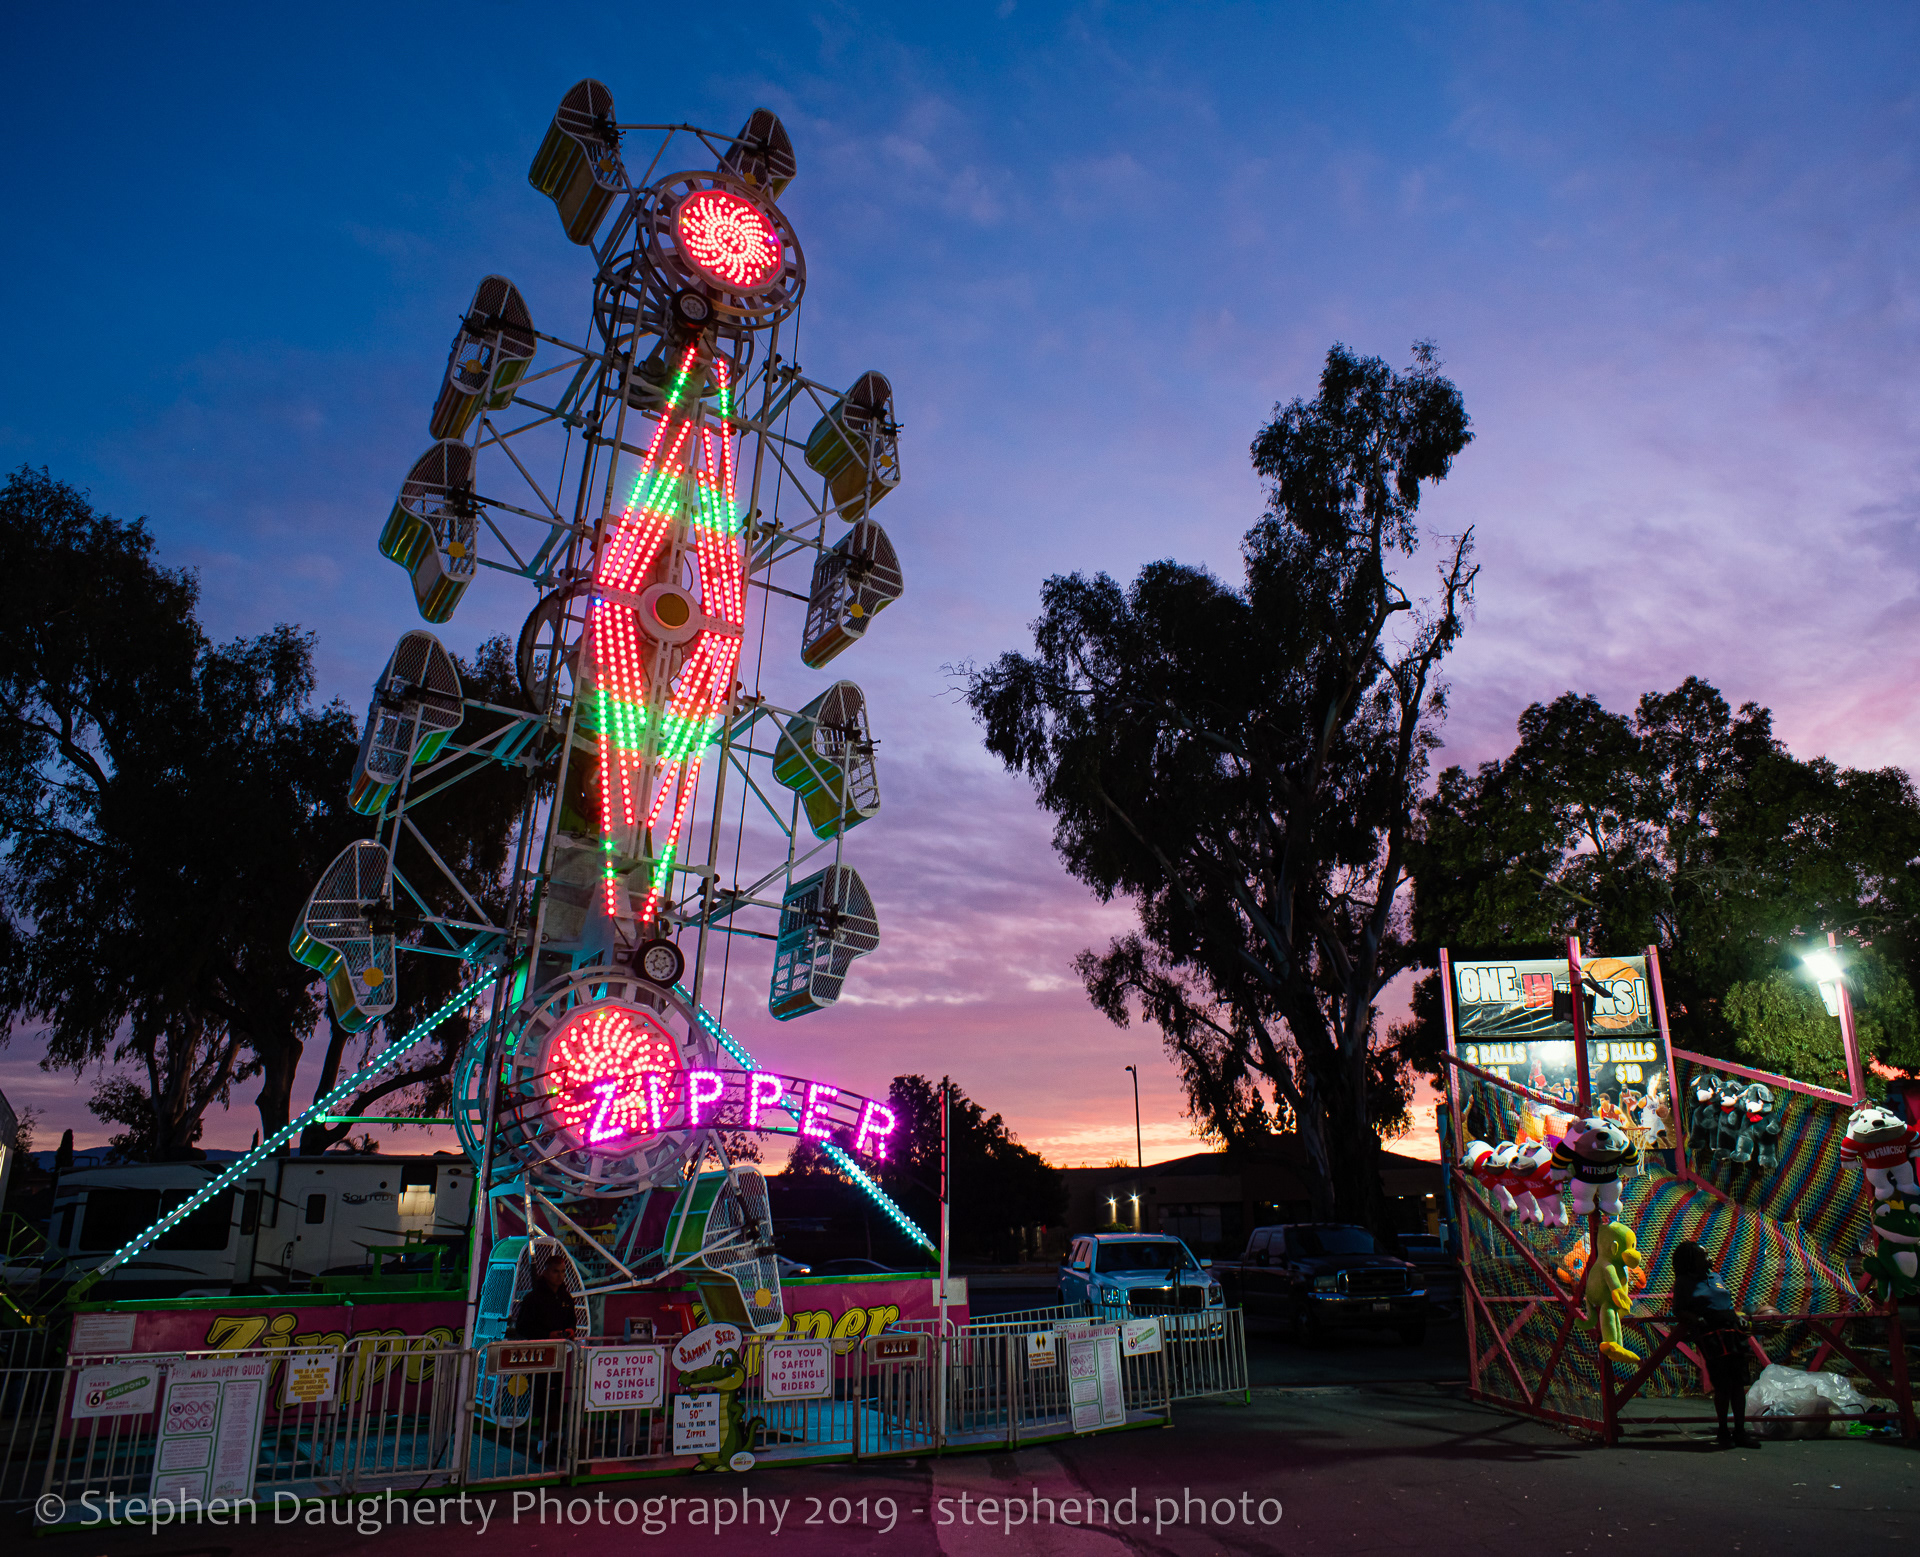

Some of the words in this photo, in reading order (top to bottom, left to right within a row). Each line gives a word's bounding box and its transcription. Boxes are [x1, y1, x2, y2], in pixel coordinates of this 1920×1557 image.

[1459, 966, 1519, 1004] ONE
[1521, 972, 1553, 1010] IN
[1556, 977, 1648, 1017] NS!
[1466, 1045, 1479, 1064] 2
[1479, 1044, 1526, 1065] BALLS
[1596, 1042, 1609, 1063] 5
[1610, 1042, 1657, 1063] BALLS
[1615, 1064, 1643, 1084] $10
[589, 1070, 897, 1160] ZIPPER
[1864, 1149, 1876, 1159] SAN
[1875, 1145, 1906, 1158] FRANCISCO
[342, 1192, 396, 1202] SOLITUDE
[1068, 1331, 1076, 1340] FUN
[1078, 1330, 1087, 1339] AND
[1088, 1328, 1102, 1338] SAFETY
[1104, 1326, 1116, 1336] GUIDE
[679, 1339, 712, 1363] SAMMY
[774, 1350, 792, 1358] FOR
[798, 1348, 822, 1357] YOUR
[884, 1341, 910, 1354] EXIT
[206, 1312, 464, 1410] Zippe
[510, 1348, 546, 1363] EXIT
[598, 1357, 619, 1366] FOR
[625, 1355, 653, 1364] YOUR
[190, 1368, 208, 1378] AND
[212, 1367, 238, 1377] SAFETY
[242, 1364, 265, 1376] GUIDE
[782, 1360, 814, 1369] SAFETY
[607, 1367, 644, 1377] SAFETY
[772, 1372, 786, 1380] NO
[792, 1370, 824, 1379] SINGLE
[106, 1380, 146, 1396] COUPONS
[594, 1380, 610, 1389] NO
[618, 1378, 655, 1388] SINGLE
[781, 1381, 815, 1391] RIDERS
[90, 1392, 100, 1405] 6
[605, 1390, 644, 1400] RIDERS
[682, 1402, 691, 1410] YOU
[686, 1429, 706, 1439] ZIPPER
